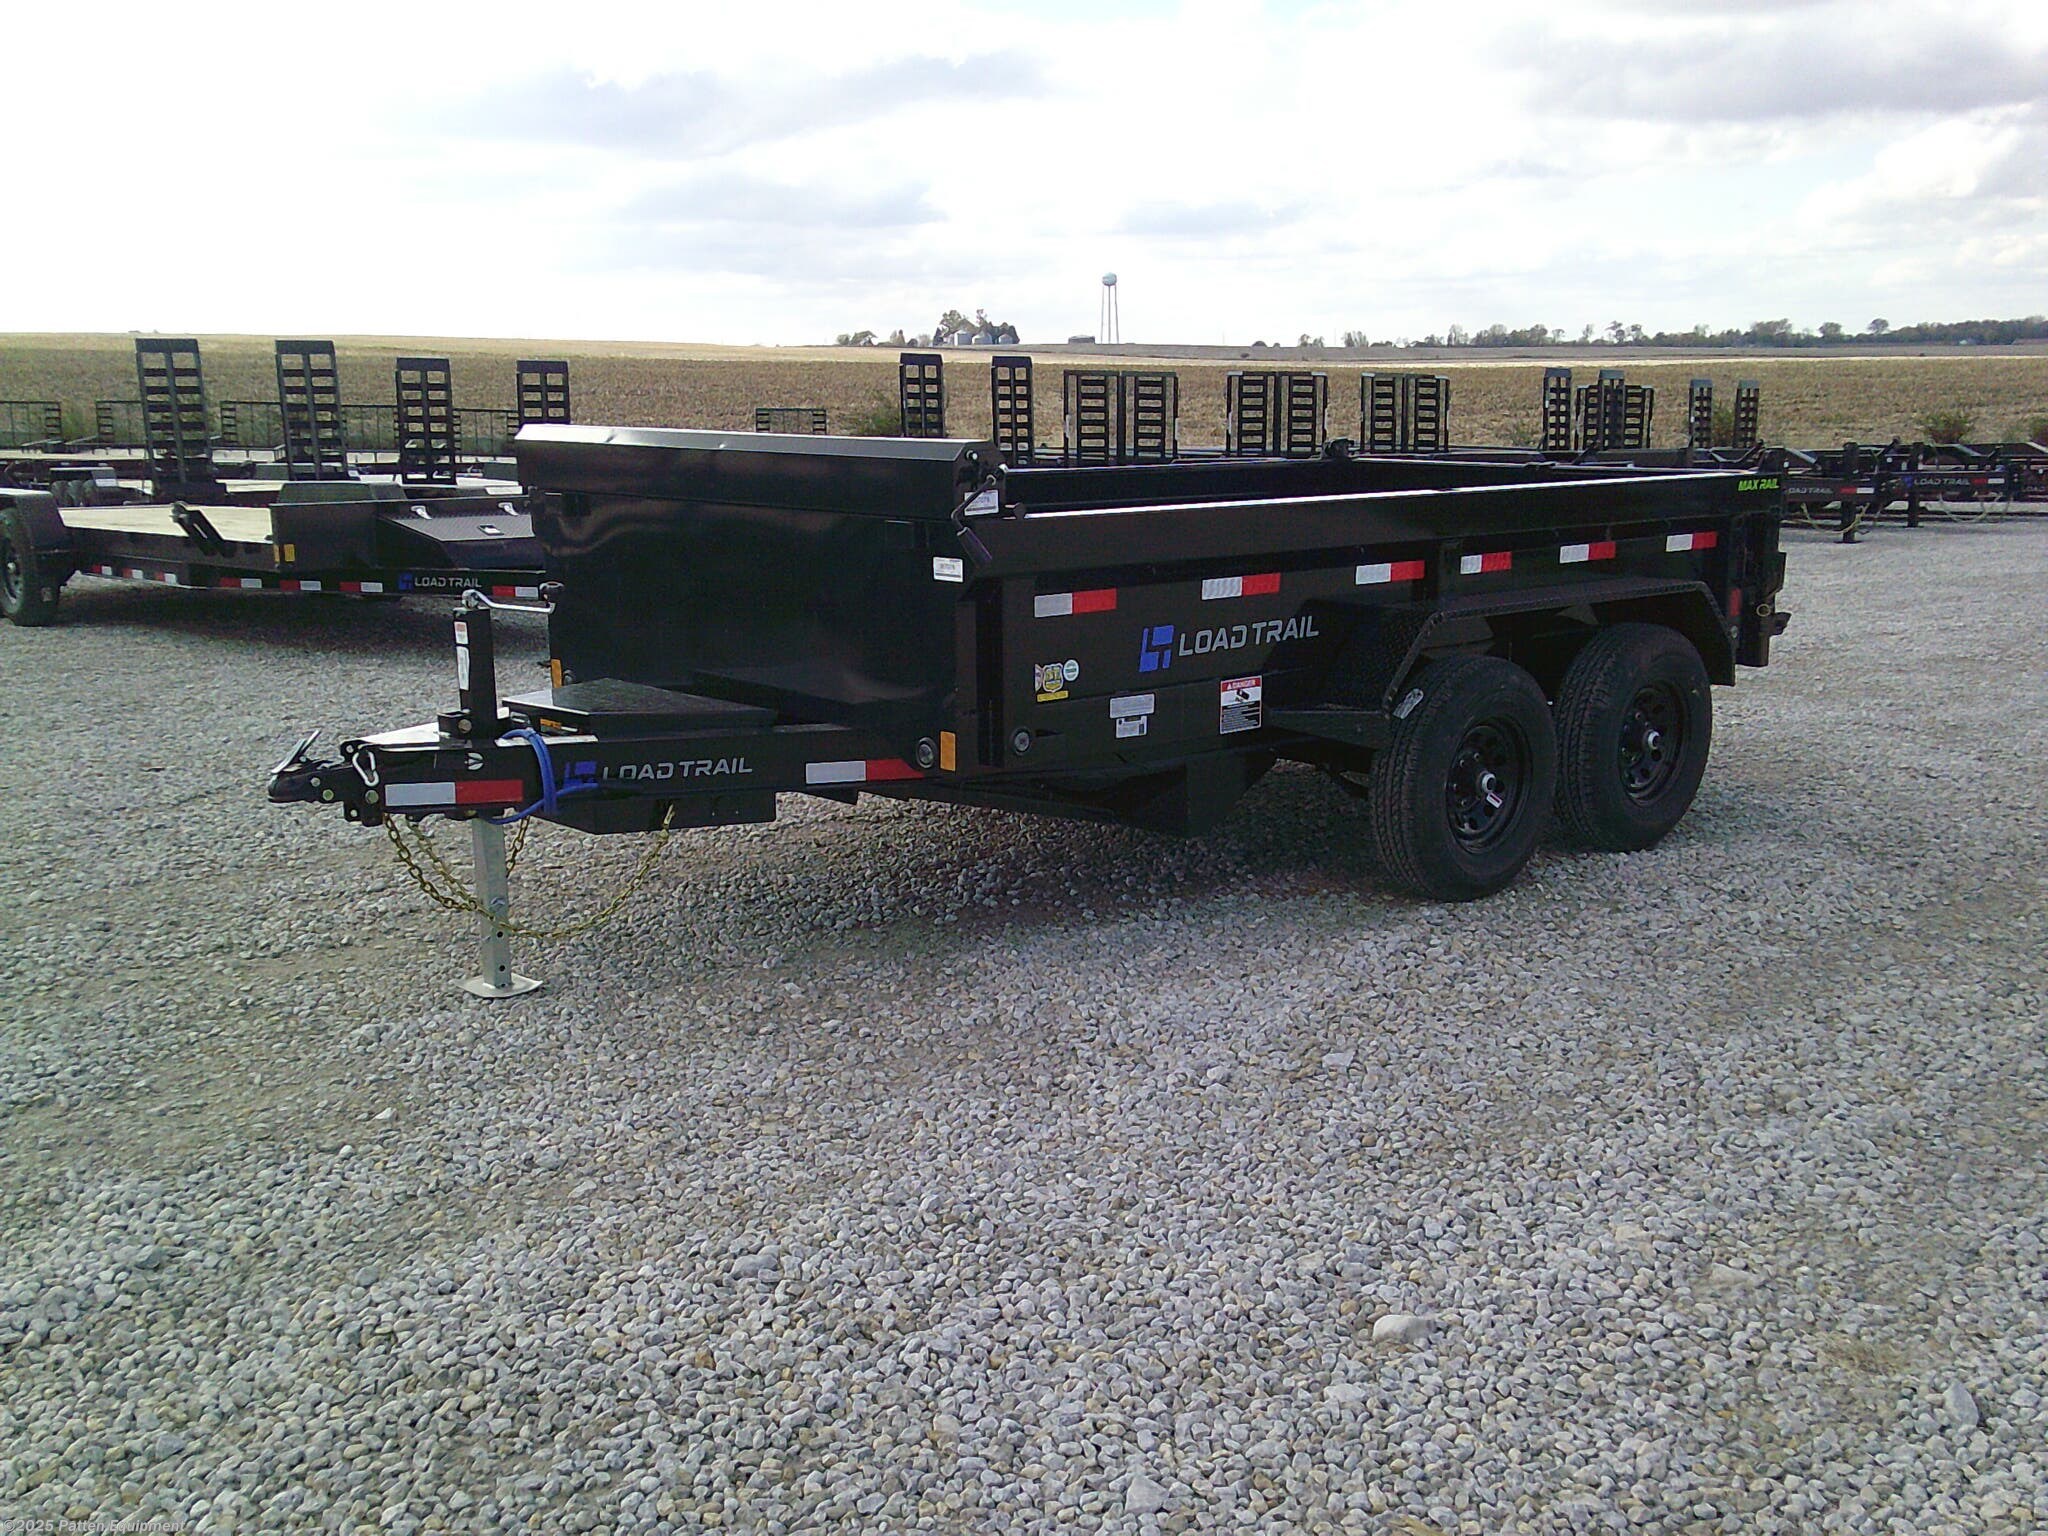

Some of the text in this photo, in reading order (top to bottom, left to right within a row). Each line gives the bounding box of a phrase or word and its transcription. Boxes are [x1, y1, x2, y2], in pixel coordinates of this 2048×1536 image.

[1738, 478, 1780, 491] MAX RAIL
[414, 577, 482, 588] LOAD TRAIL
[1178, 615, 1320, 657] LOAD TRAIL
[678, 757, 753, 777] TRAIL
